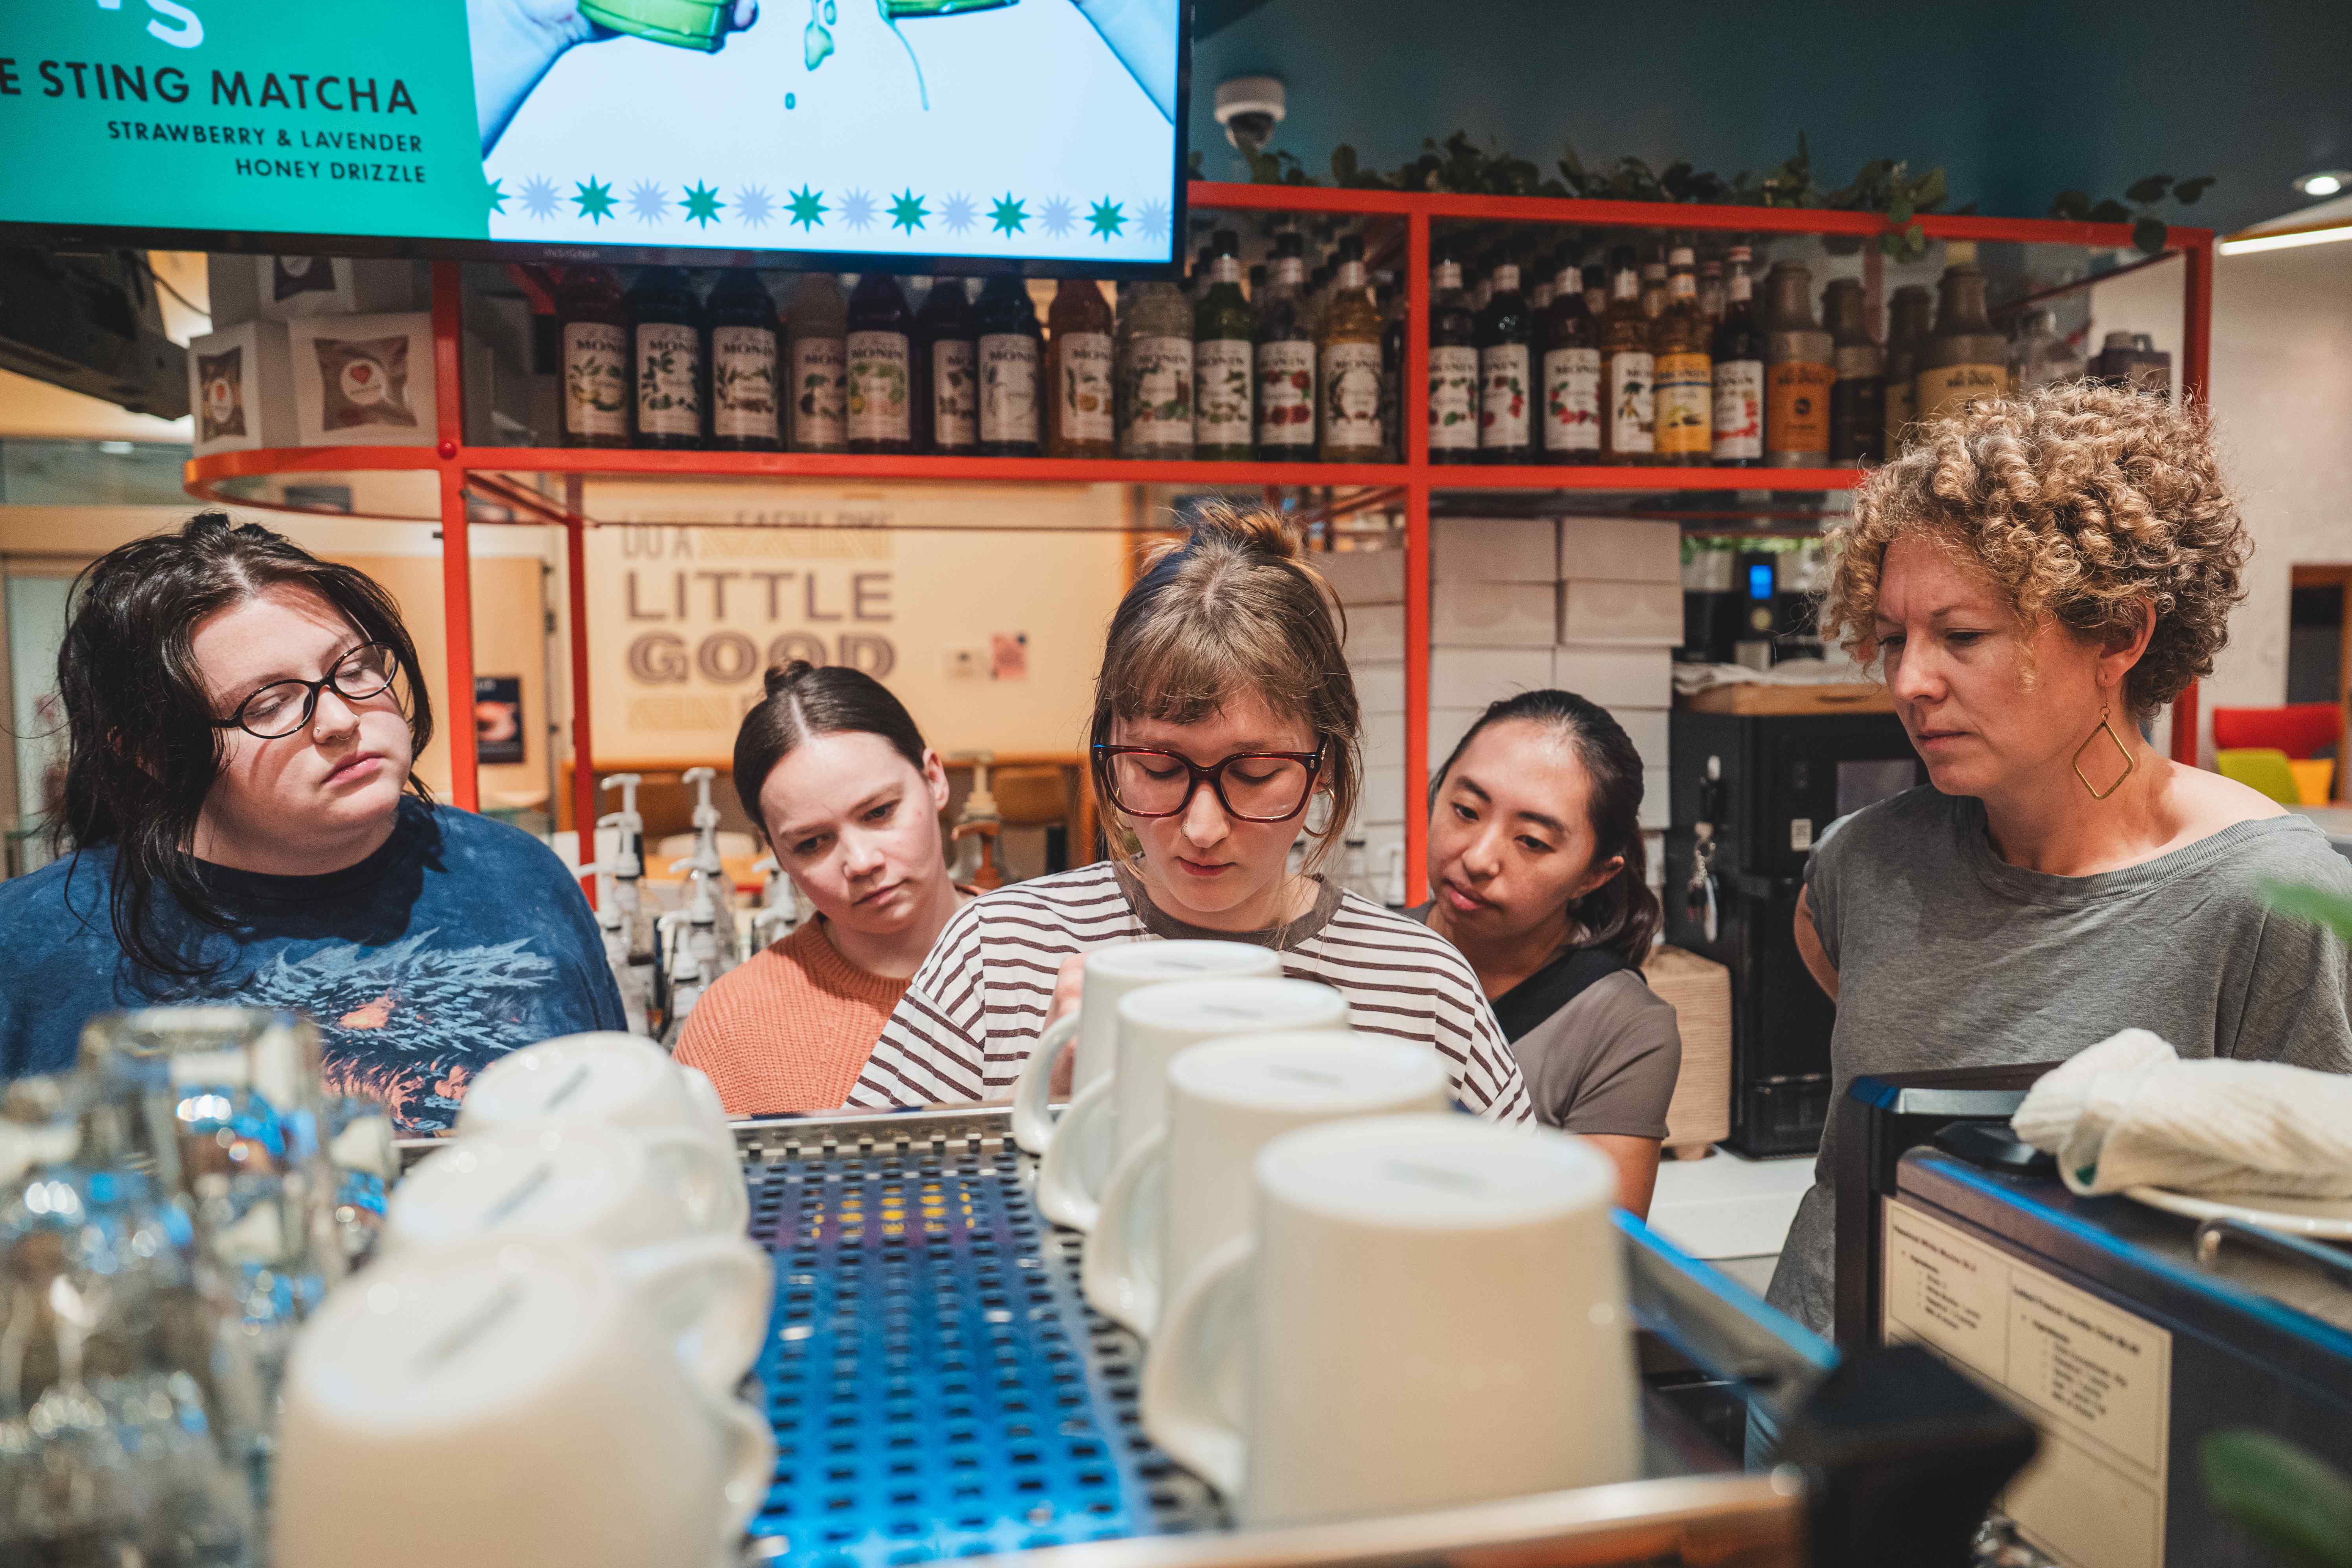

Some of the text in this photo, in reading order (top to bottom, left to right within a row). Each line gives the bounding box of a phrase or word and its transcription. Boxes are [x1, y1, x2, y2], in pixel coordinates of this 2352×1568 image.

[39, 60, 189, 102] STING
[211, 70, 418, 115] MATCHA
[107, 120, 422, 153] STRAWBERRY & LAVENDER
[236, 158, 426, 183] HONEY DRIZZLE
[626, 570, 894, 621] LITTLE
[627, 630, 896, 685] GOOD
